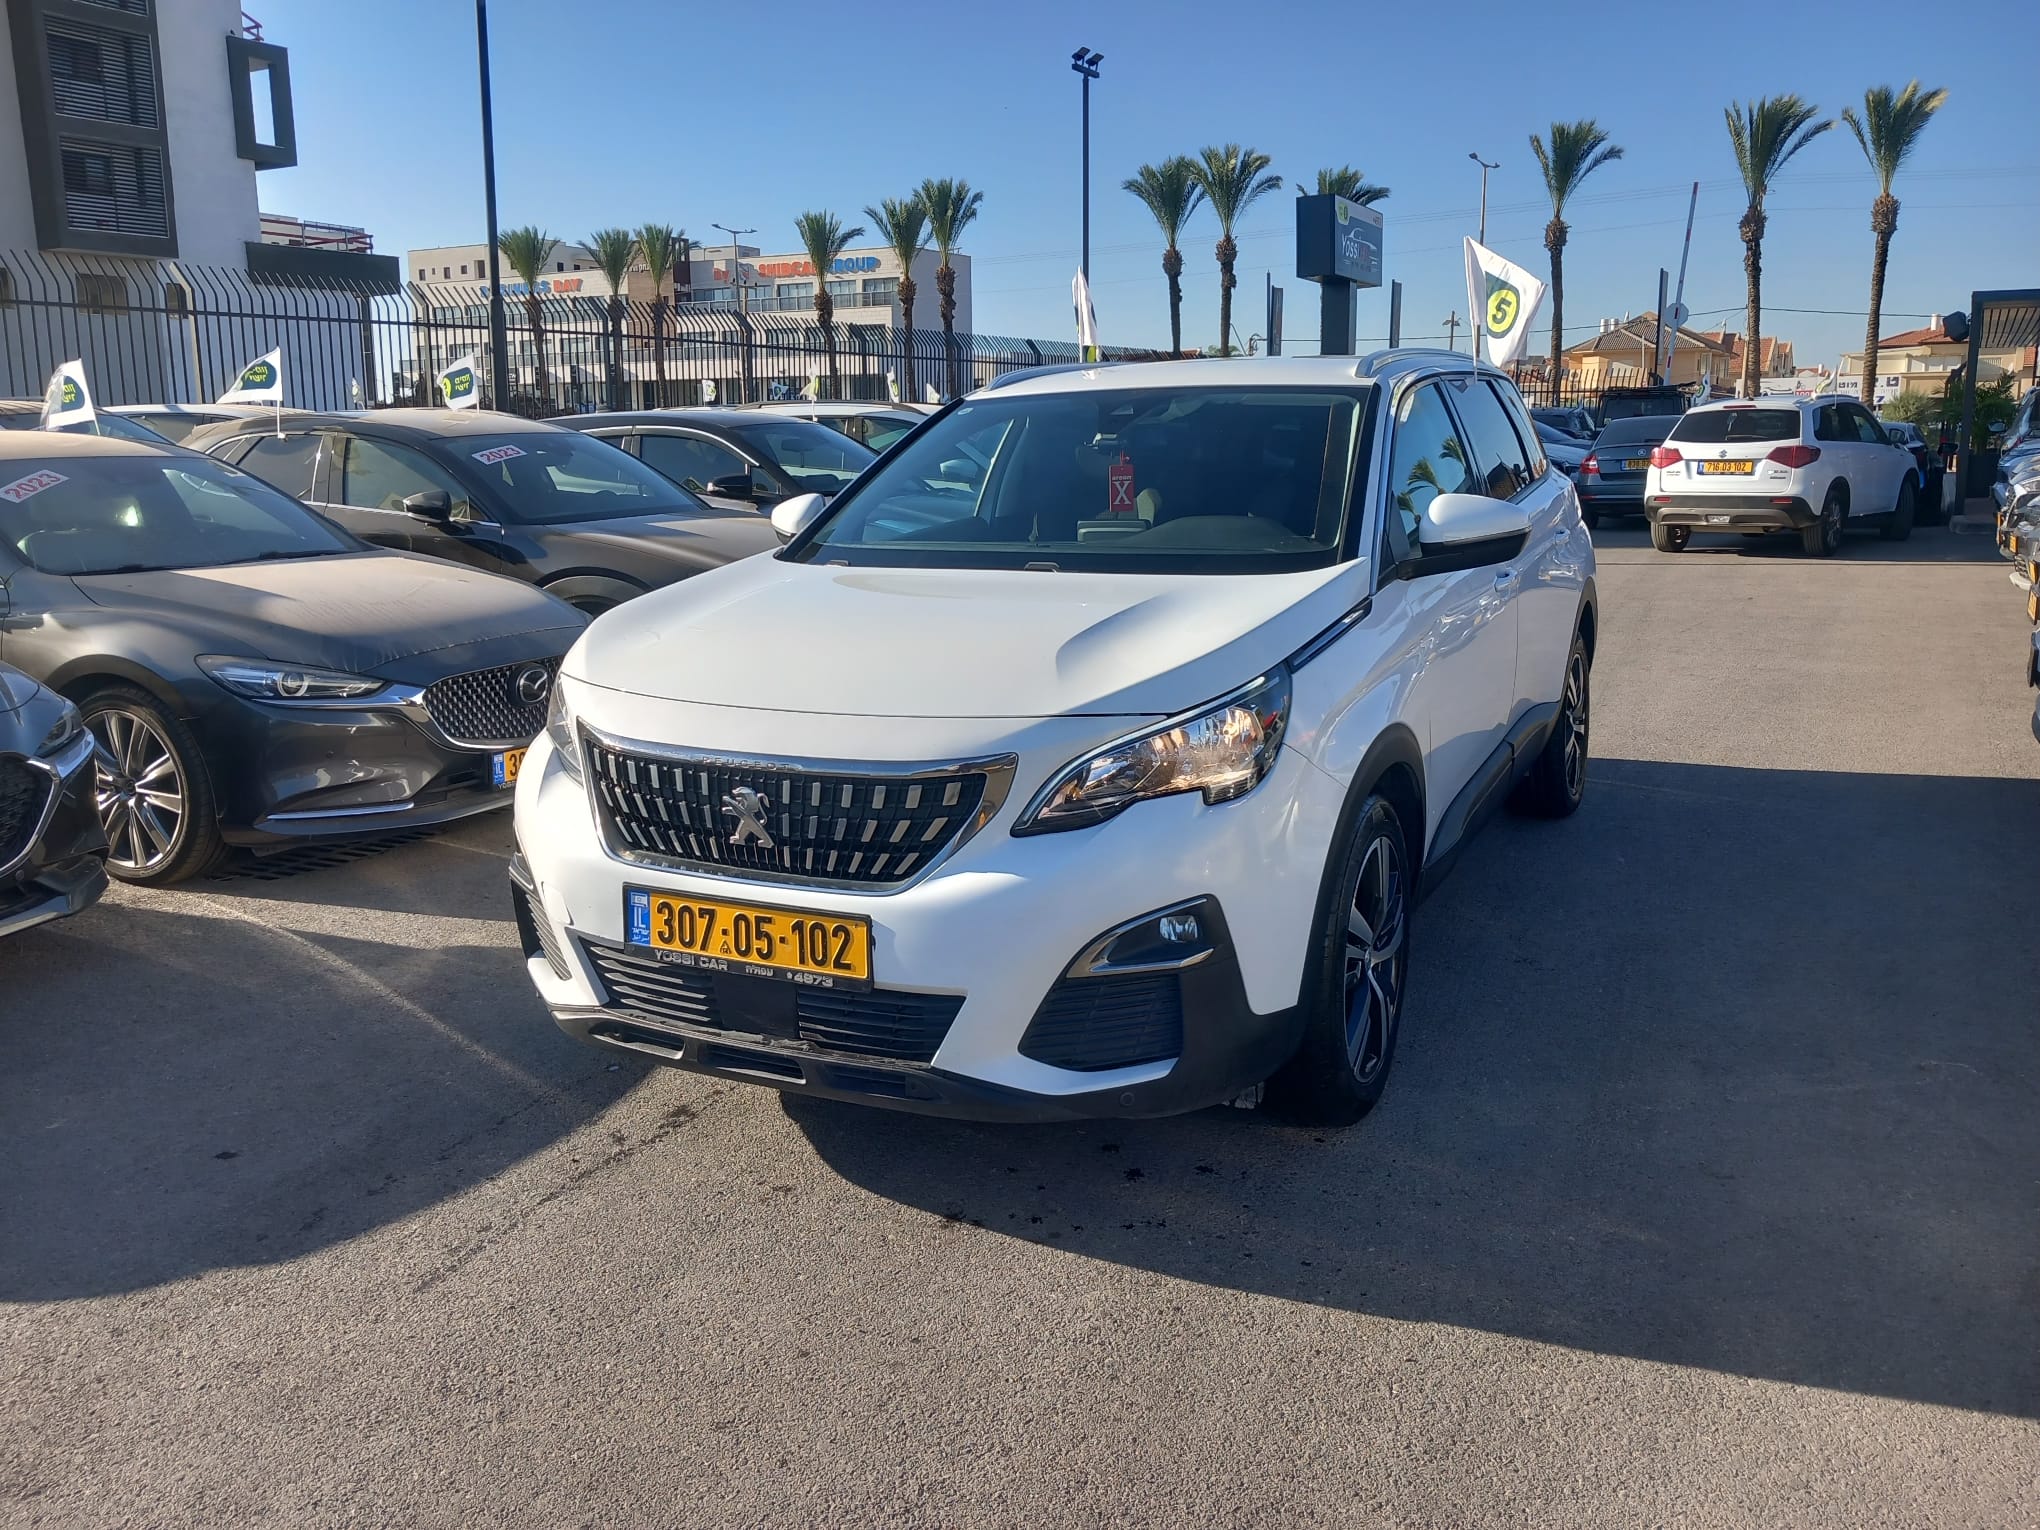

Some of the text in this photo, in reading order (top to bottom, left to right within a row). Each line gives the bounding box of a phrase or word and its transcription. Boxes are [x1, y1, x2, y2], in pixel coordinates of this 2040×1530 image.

[1491, 297, 1512, 324] 5
[480, 447, 521, 463] 2023
[4, 473, 61, 500] 2023
[1111, 480, 1132, 505] X
[633, 906, 647, 929] IL
[700, 956, 729, 972] CAR
